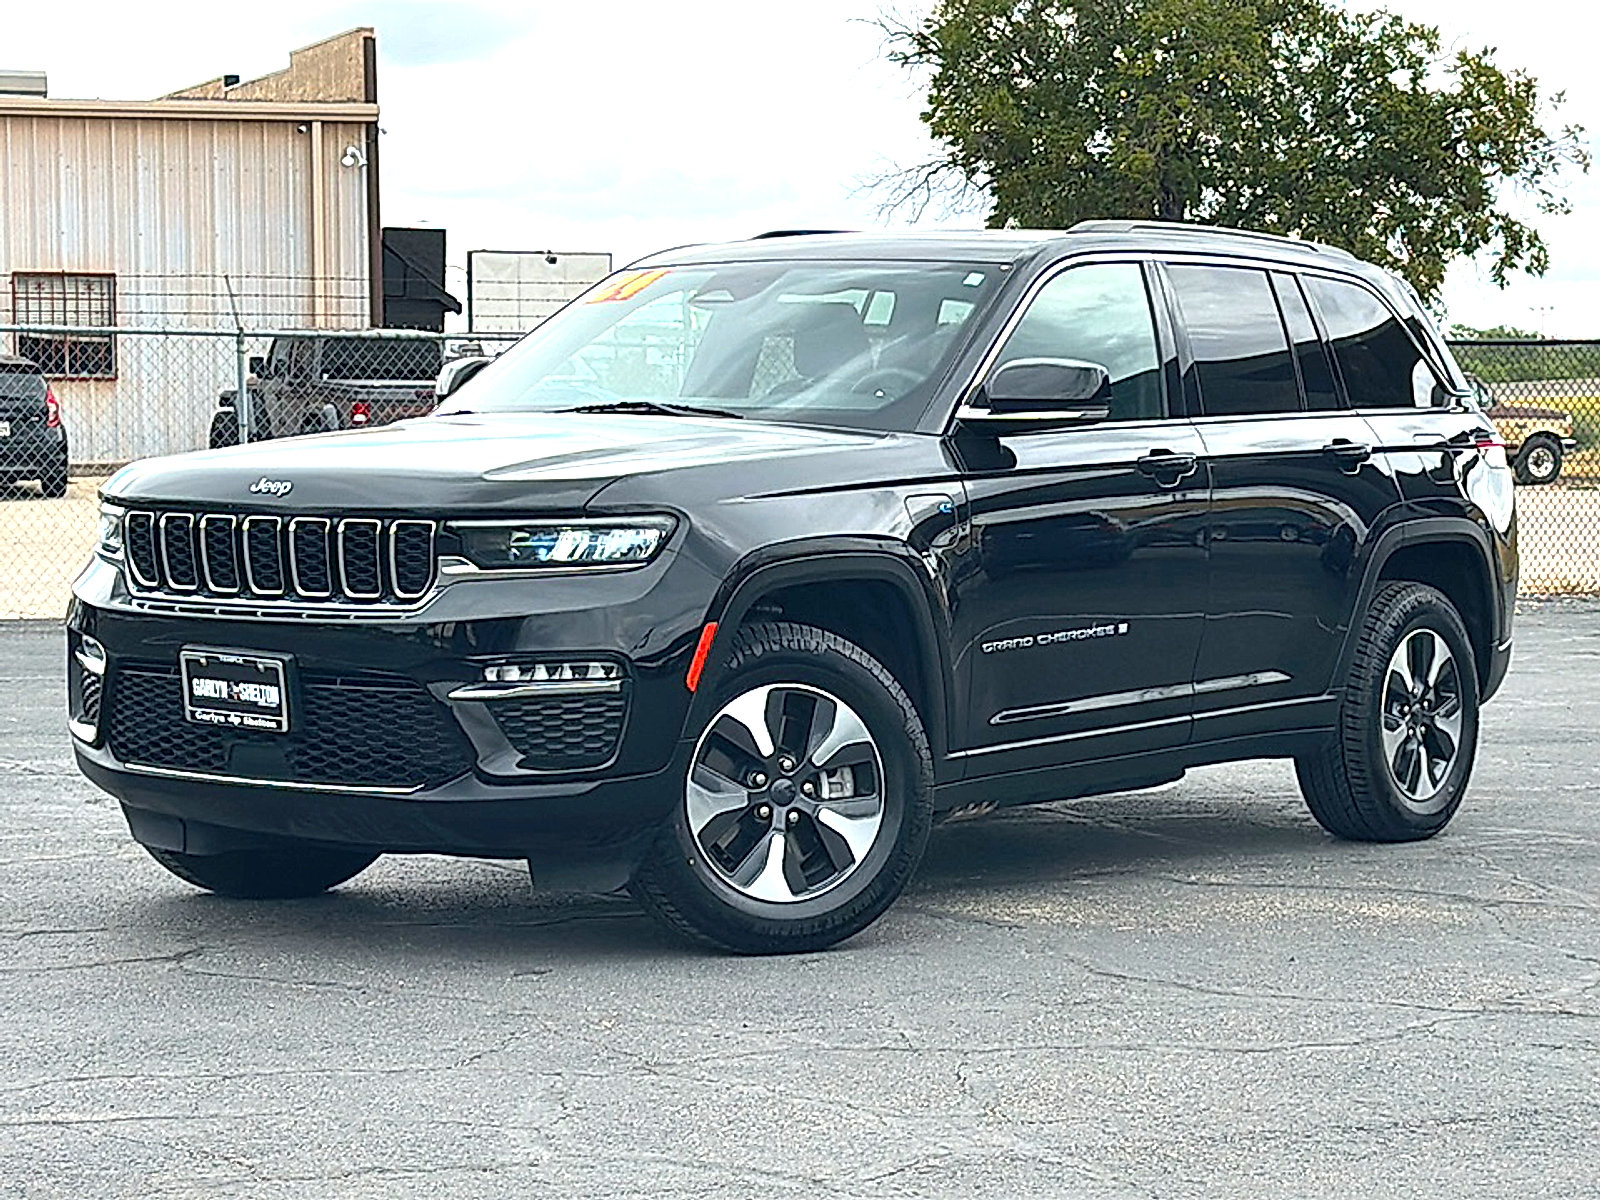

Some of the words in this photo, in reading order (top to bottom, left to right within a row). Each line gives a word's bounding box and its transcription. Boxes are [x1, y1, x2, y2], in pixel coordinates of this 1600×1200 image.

[250, 477, 292, 497] Jeep
[982, 636, 1034, 653] GRAND
[1036, 625, 1115, 645] CHEROKEE
[239, 682, 280, 704] SHELTON
